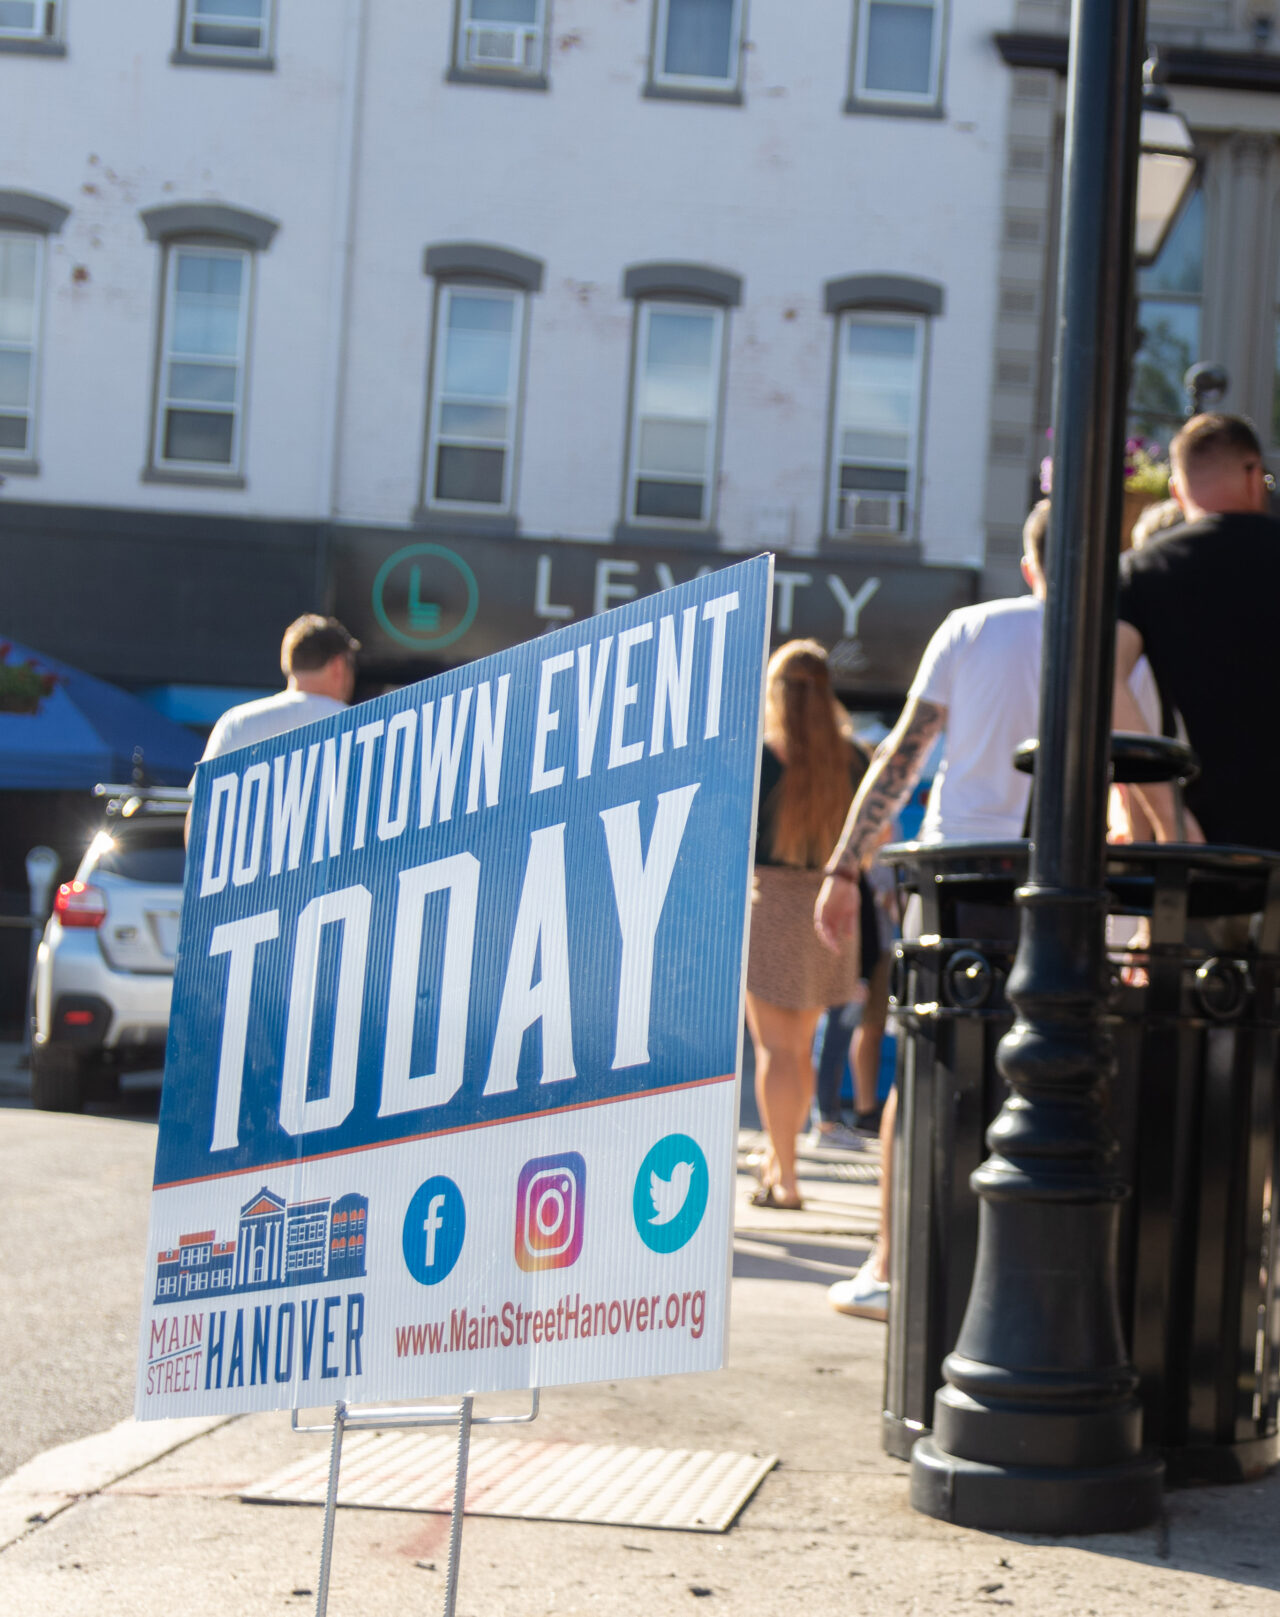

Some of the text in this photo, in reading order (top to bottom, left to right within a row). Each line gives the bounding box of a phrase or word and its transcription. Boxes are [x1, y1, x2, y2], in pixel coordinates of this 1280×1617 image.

[534, 554, 880, 637] LETY
[200, 591, 739, 898] DOWNTOWN EVENT
[208, 782, 701, 1152] TODAY
[148, 1313, 204, 1359] MAIN
[205, 1292, 365, 1391] HANOVER
[396, 1290, 706, 1358] www.MainStreetHanover.org
[146, 1351, 203, 1396] STREET
